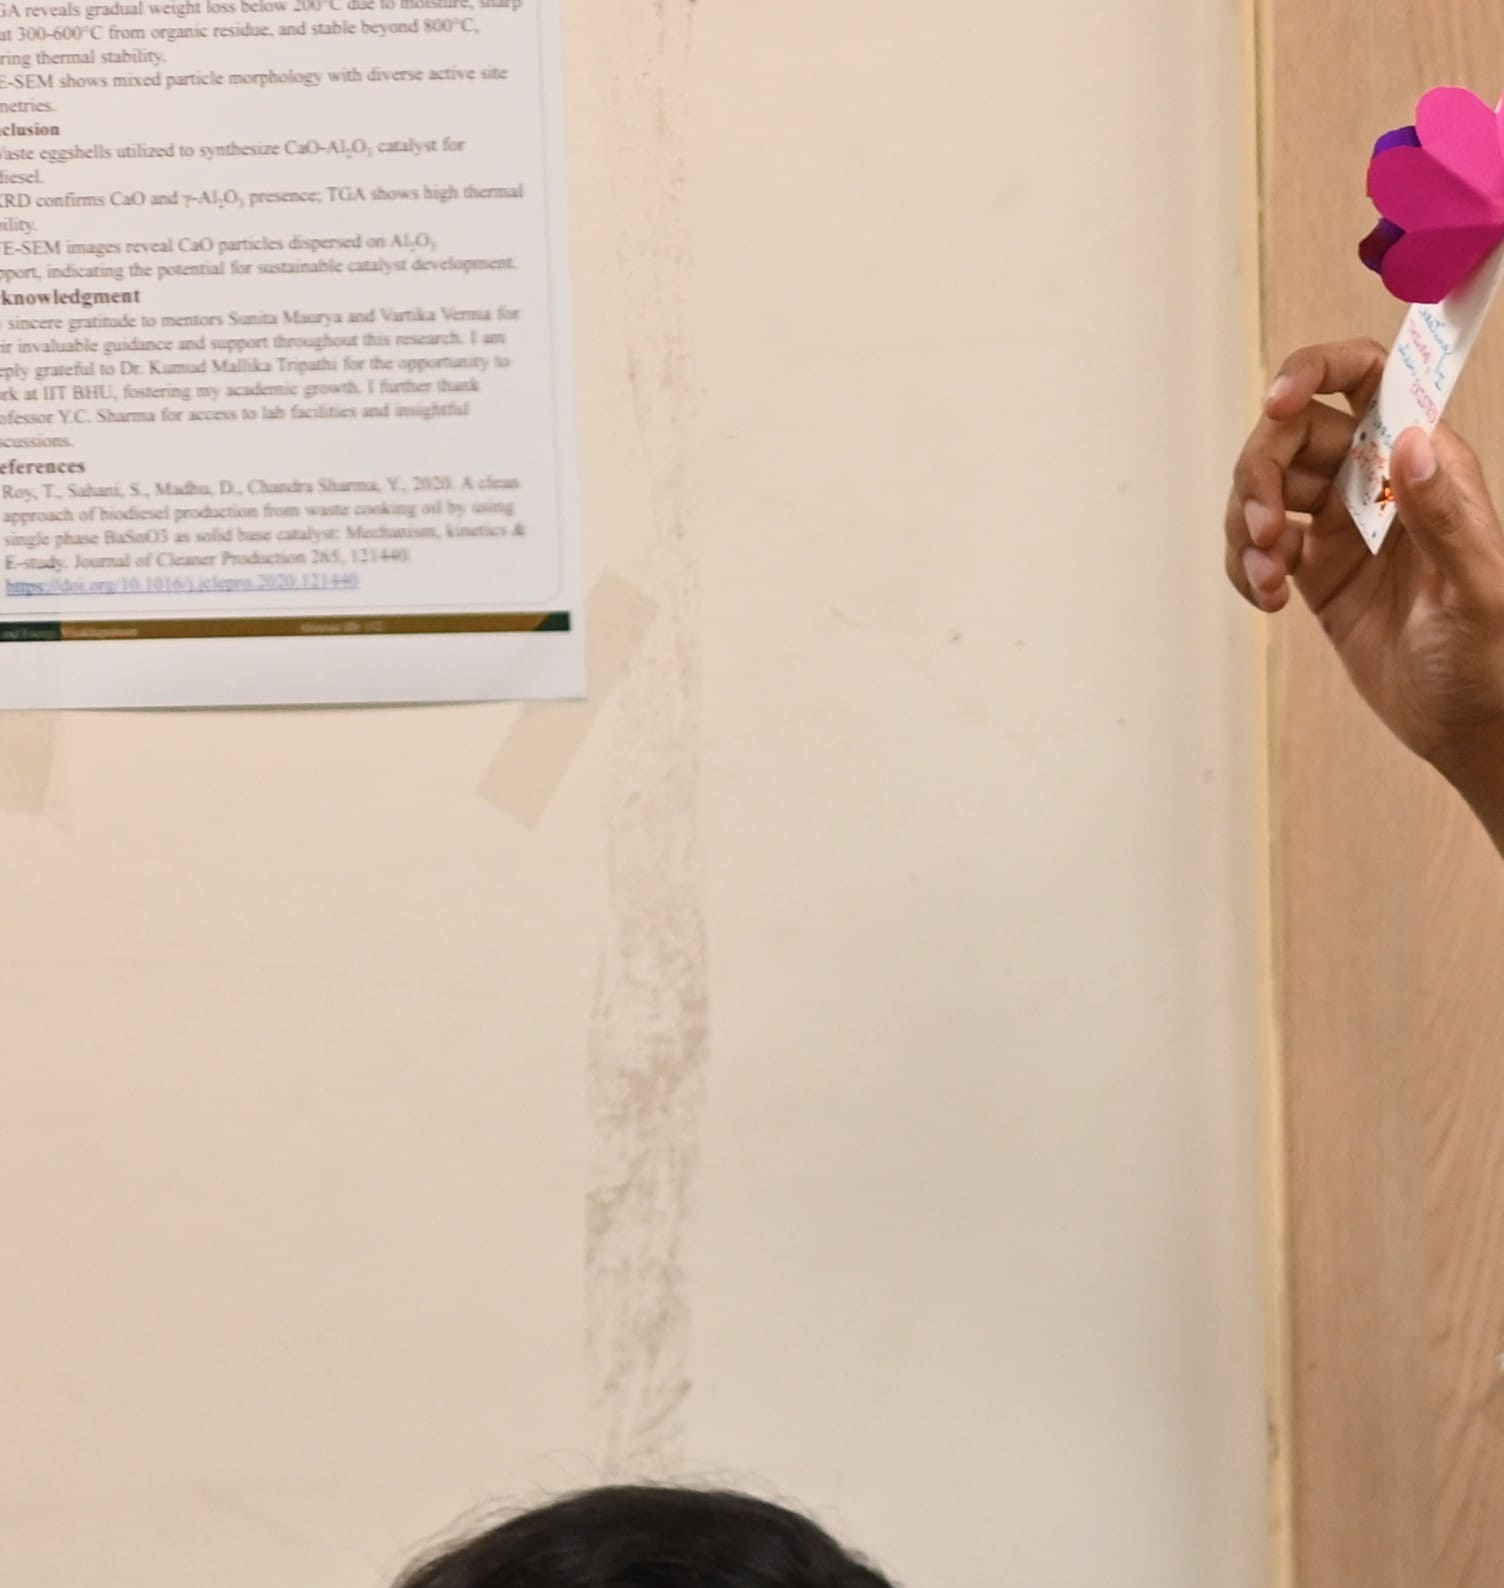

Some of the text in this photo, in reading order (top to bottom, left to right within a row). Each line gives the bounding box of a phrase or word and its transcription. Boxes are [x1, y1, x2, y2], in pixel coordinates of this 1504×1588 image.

[59, 73, 108, 89] shows
[112, 72, 163, 87] mixed
[163, 70, 225, 90] particle
[228, 69, 323, 88] morphology
[328, 67, 363, 83] with
[366, 66, 425, 82] diverse
[427, 65, 476, 80] active
[480, 64, 507, 79] site
[0, 122, 61, 137] clusion
[0, 288, 140, 308] knowledgment
[0, 458, 87, 475] eferences
